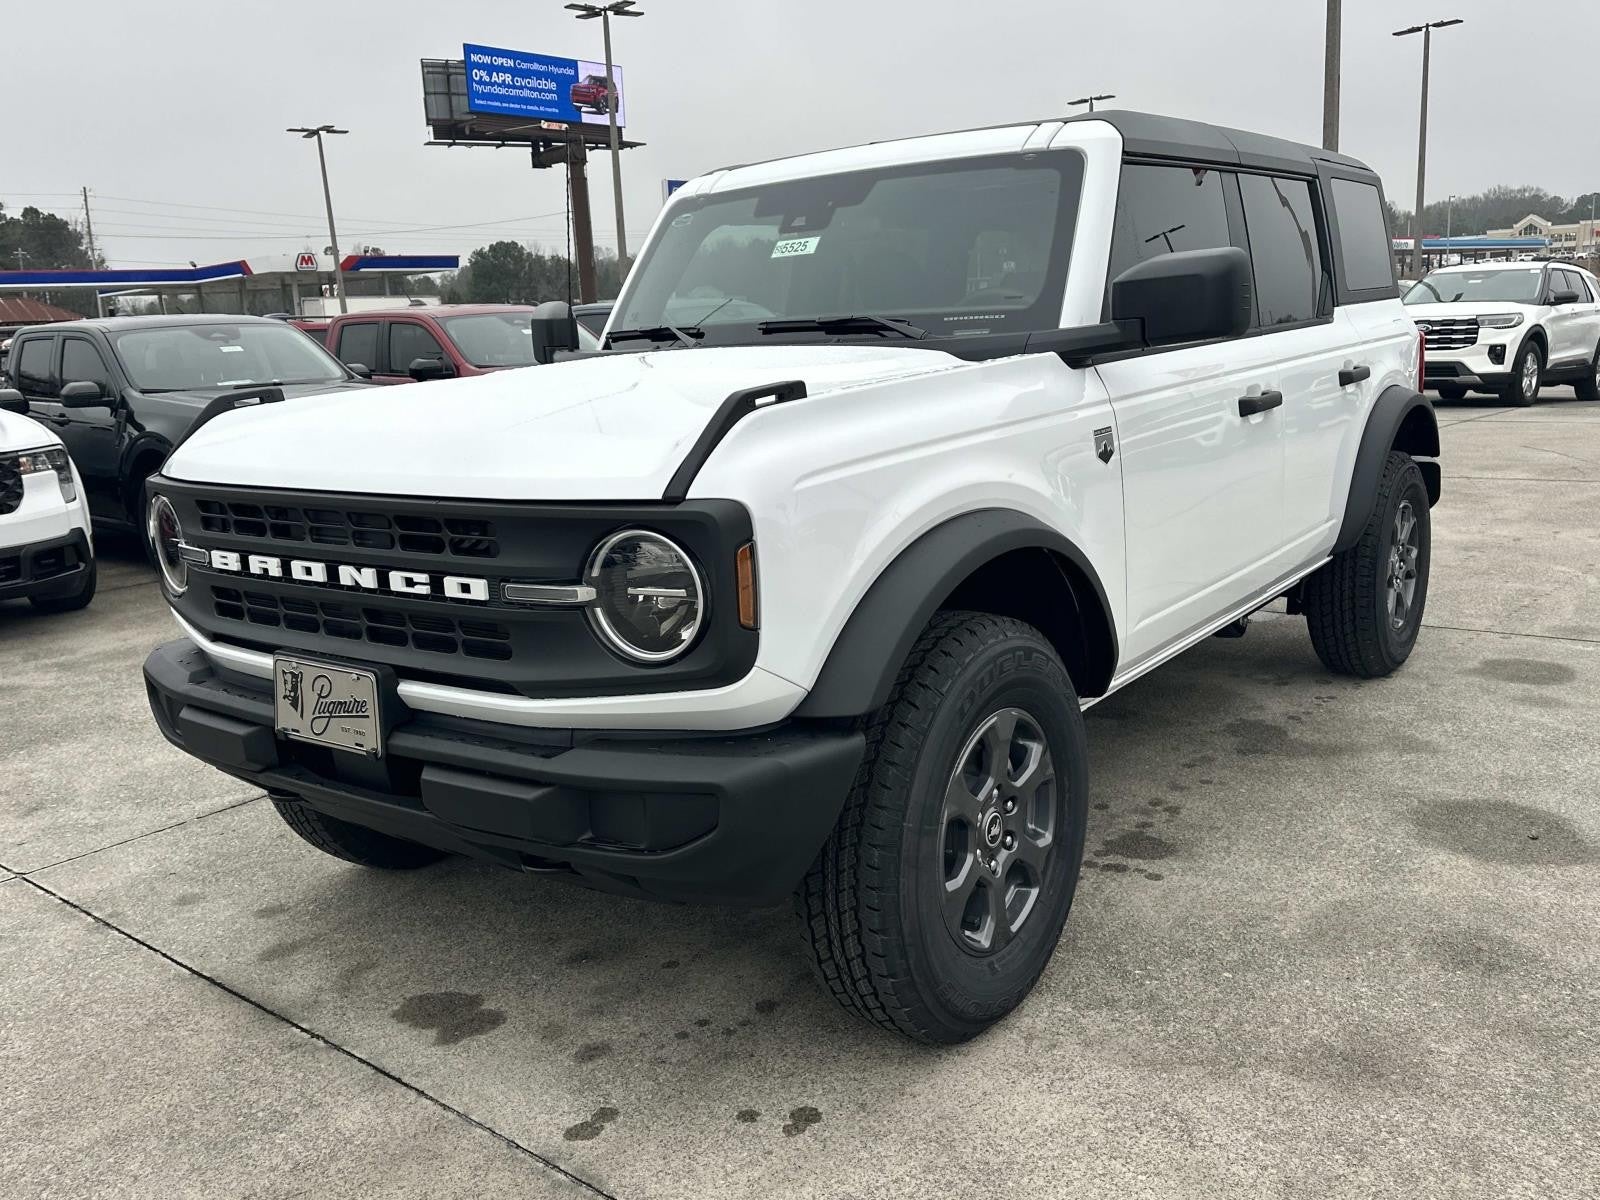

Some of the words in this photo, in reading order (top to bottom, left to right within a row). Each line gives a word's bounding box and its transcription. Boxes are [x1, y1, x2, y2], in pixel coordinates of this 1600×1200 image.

[471, 53, 491, 64] NOW
[492, 56, 514, 67] OPEN
[515, 60, 548, 71] Carrollton
[548, 65, 575, 75] Hyundai
[472, 69, 490, 82] 0%
[491, 72, 513, 85] APR
[513, 76, 557, 90] available
[472, 82, 558, 101] hyundaicarrollton.com
[781, 240, 809, 254] 5525
[299, 255, 315, 266] M
[211, 549, 489, 601] BRONCO
[310, 673, 370, 736] Pugmire
